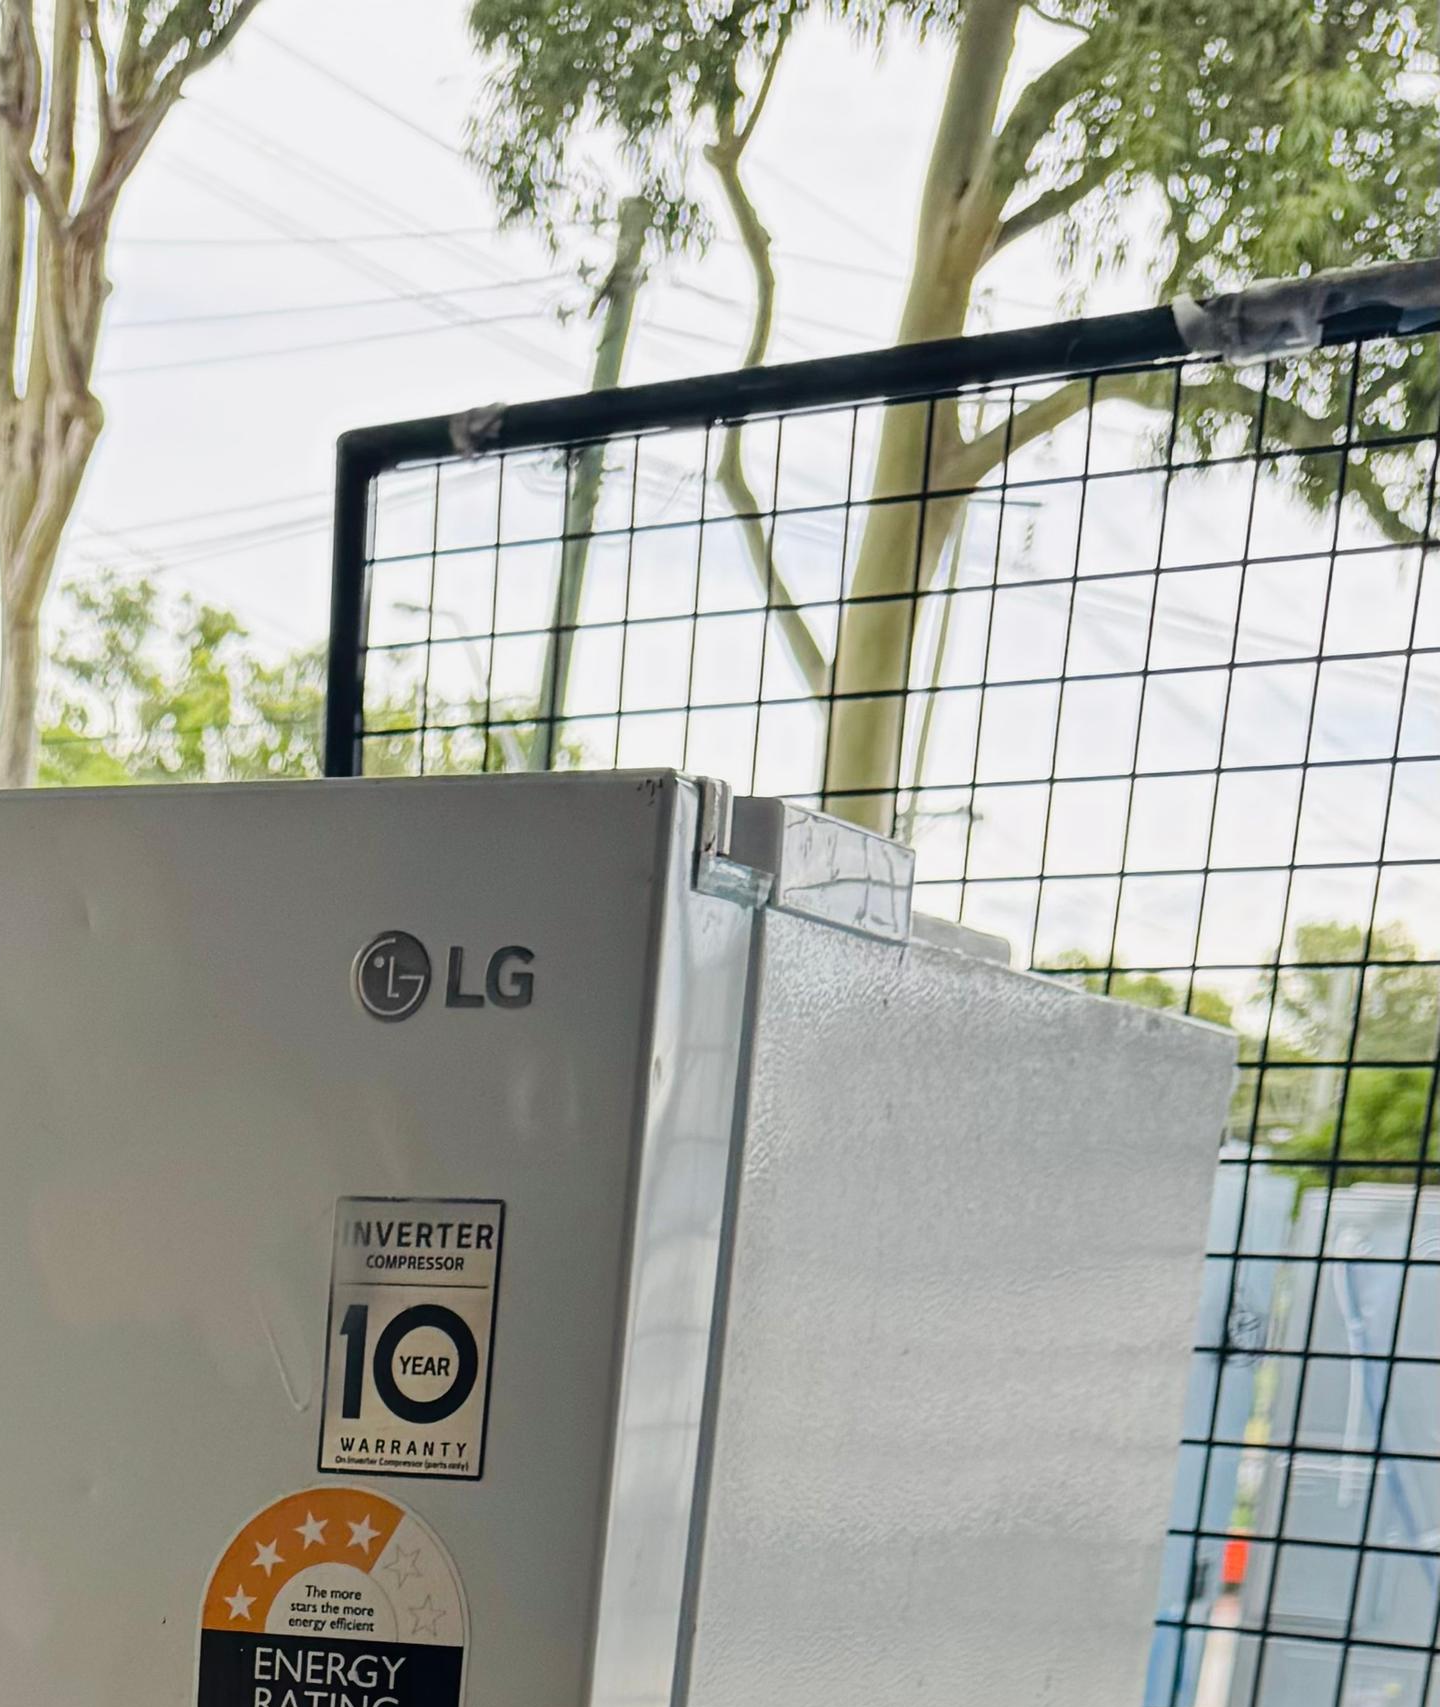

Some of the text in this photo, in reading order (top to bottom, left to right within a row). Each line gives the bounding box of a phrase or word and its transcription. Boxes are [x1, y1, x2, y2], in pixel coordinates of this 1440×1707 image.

[445, 945, 535, 1010] LG
[343, 1220, 495, 1250] INVERTER
[366, 1254, 465, 1271] COMPRESSOR
[339, 1303, 479, 1424] 10
[399, 1355, 450, 1376] YEAR
[340, 1437, 467, 1458] WARRANTY
[305, 1584, 362, 1600] The more
[290, 1601, 374, 1616] stars the more
[288, 1617, 375, 1632] energy efficient
[254, 1646, 407, 1690] ENERGY
